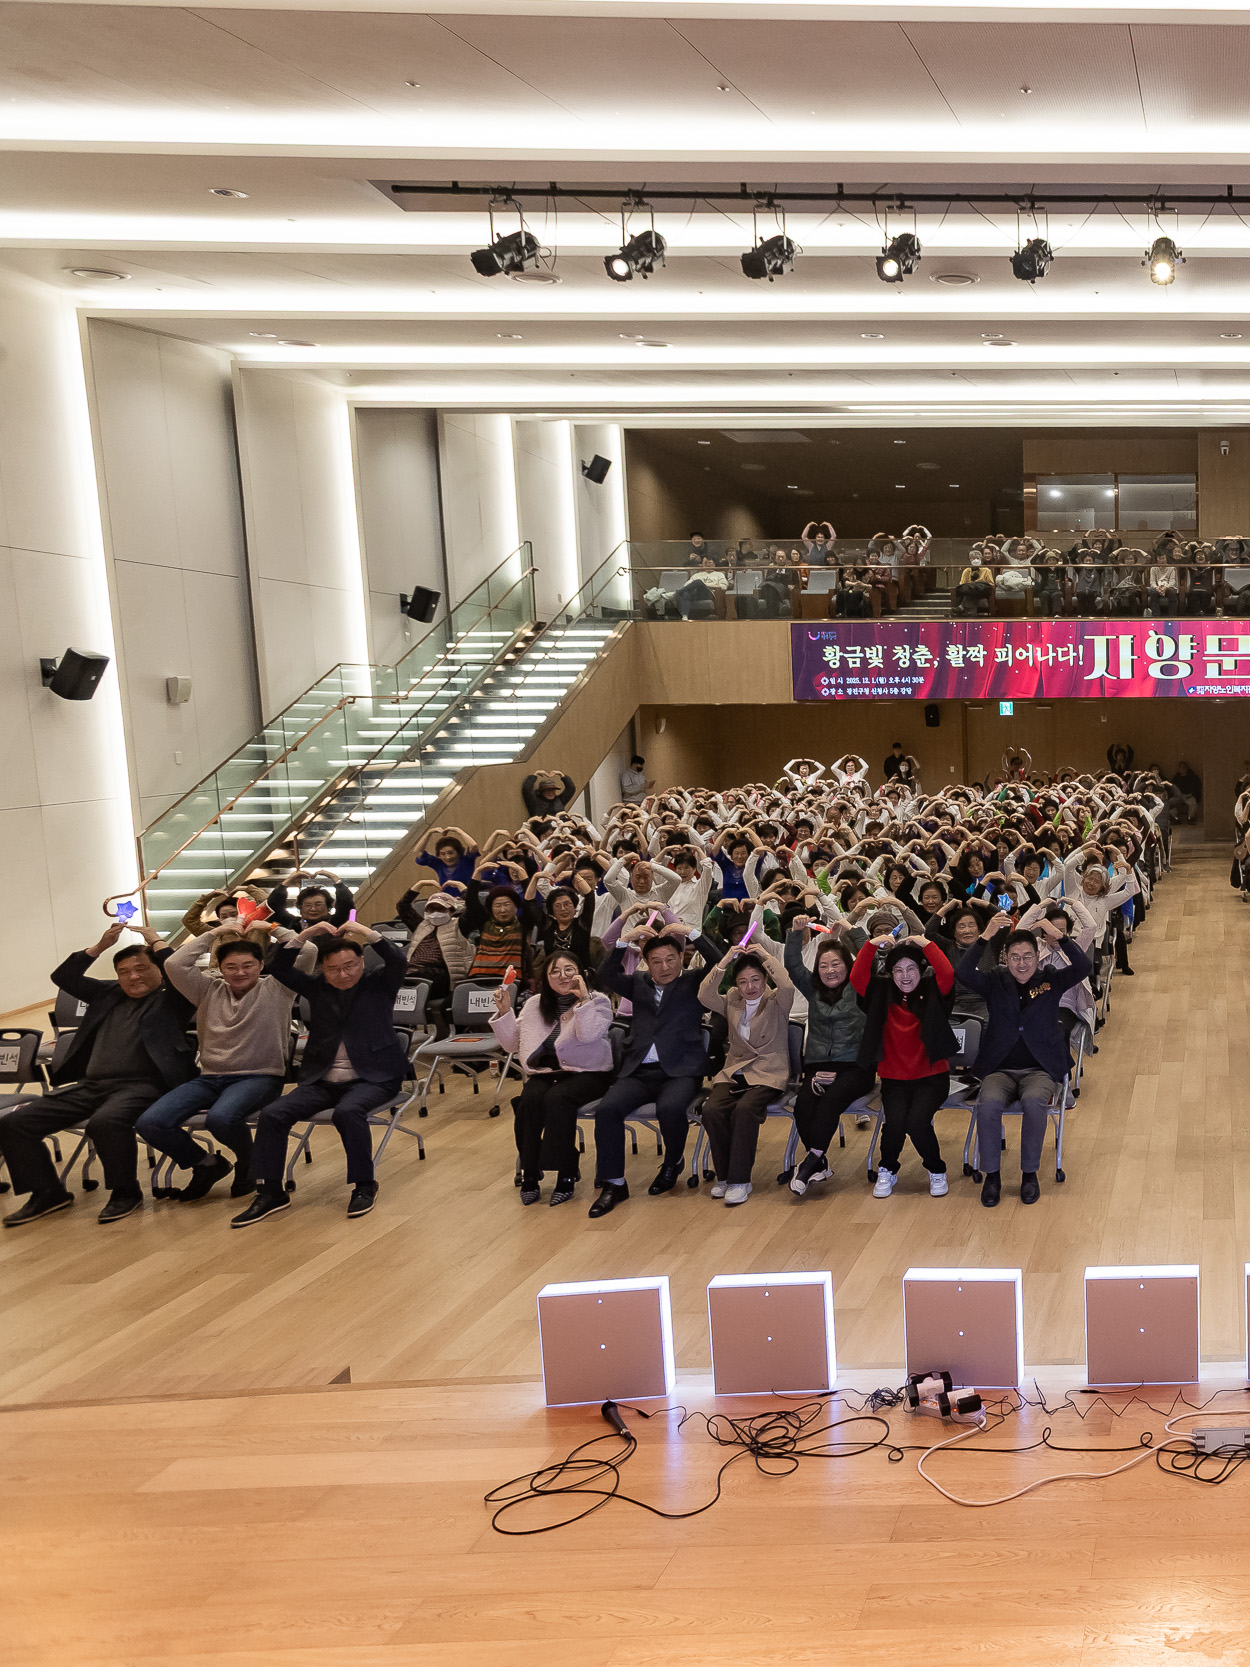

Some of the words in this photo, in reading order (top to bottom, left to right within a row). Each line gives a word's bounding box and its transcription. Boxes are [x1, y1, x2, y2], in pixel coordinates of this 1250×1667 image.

[822, 644, 884, 669] 황금빛
[892, 644, 939, 669] 청춘,
[945, 644, 988, 669] 활짝
[994, 644, 1084, 669] 피어나다!
[846, 687, 870, 695] 광진구청
[871, 687, 889, 695] 신청사
[889, 687, 900, 695] 5층
[900, 687, 913, 695] 강당
[0, 1053, 18, 1066] 빈석
